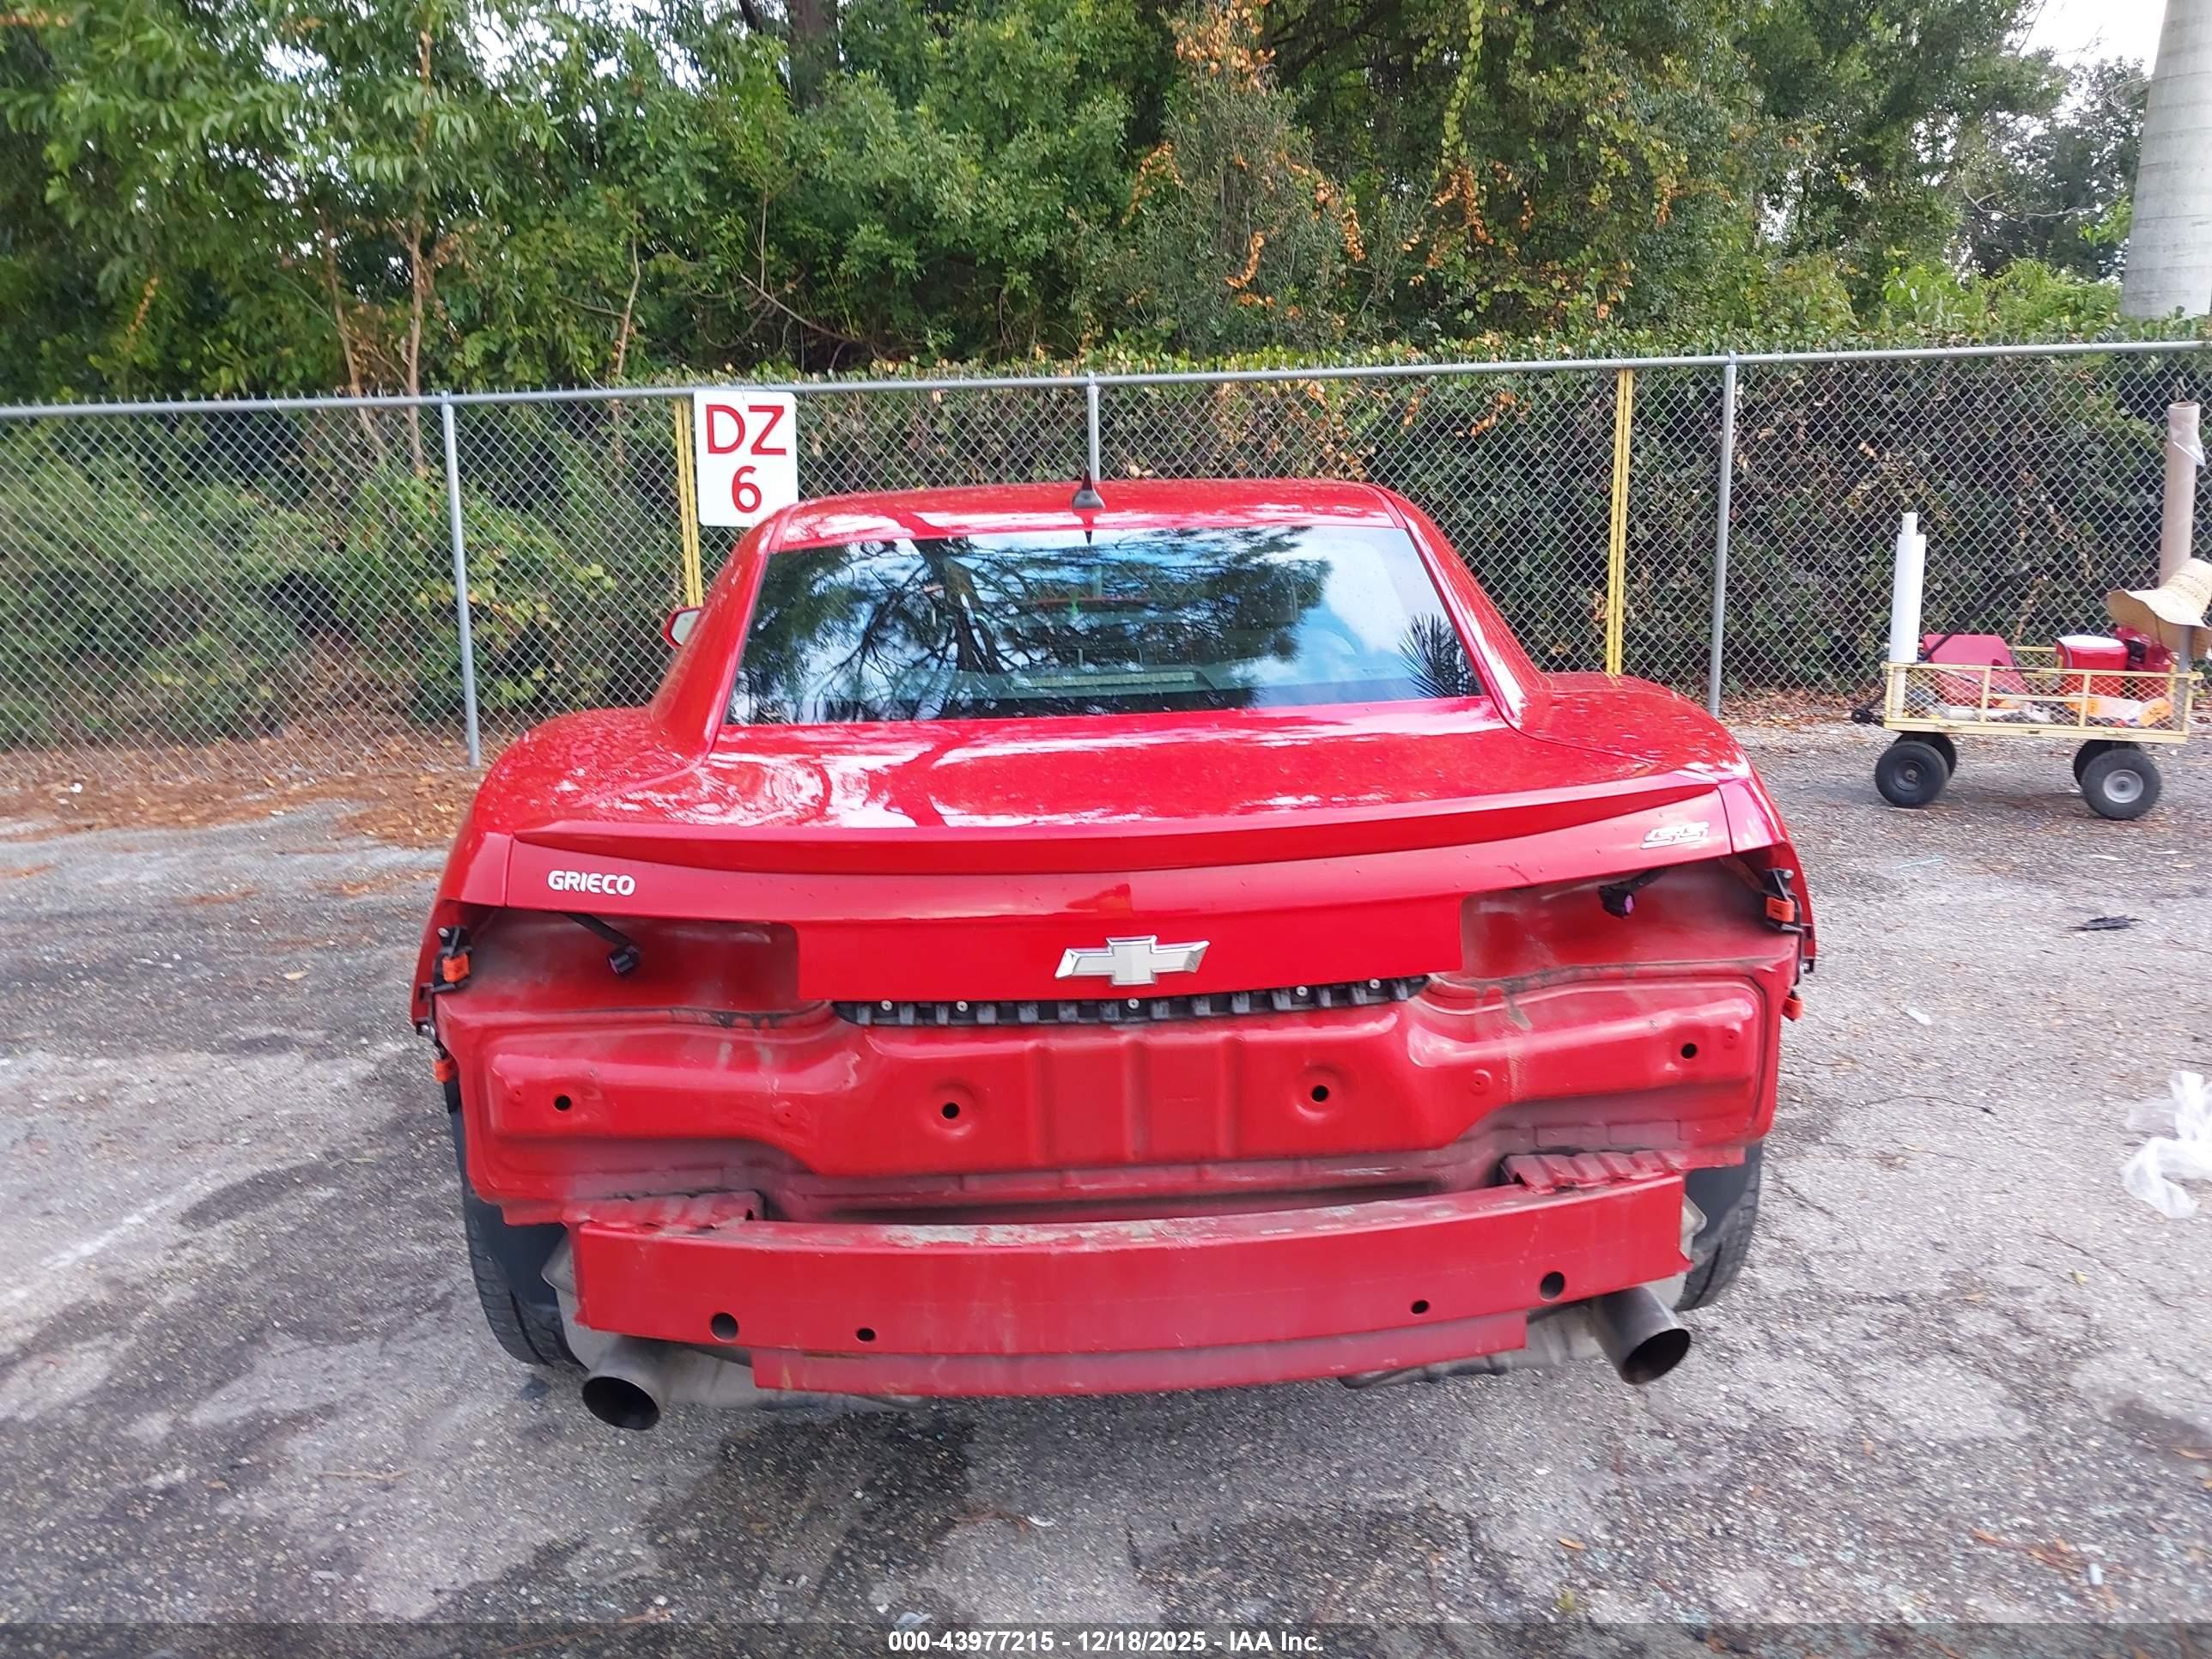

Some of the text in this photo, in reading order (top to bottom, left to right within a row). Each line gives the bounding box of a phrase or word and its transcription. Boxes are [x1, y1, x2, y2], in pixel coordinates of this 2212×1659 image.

[705, 404, 787, 456] DZ
[731, 465, 763, 514] 6
[546, 869, 636, 896] GRIECO
